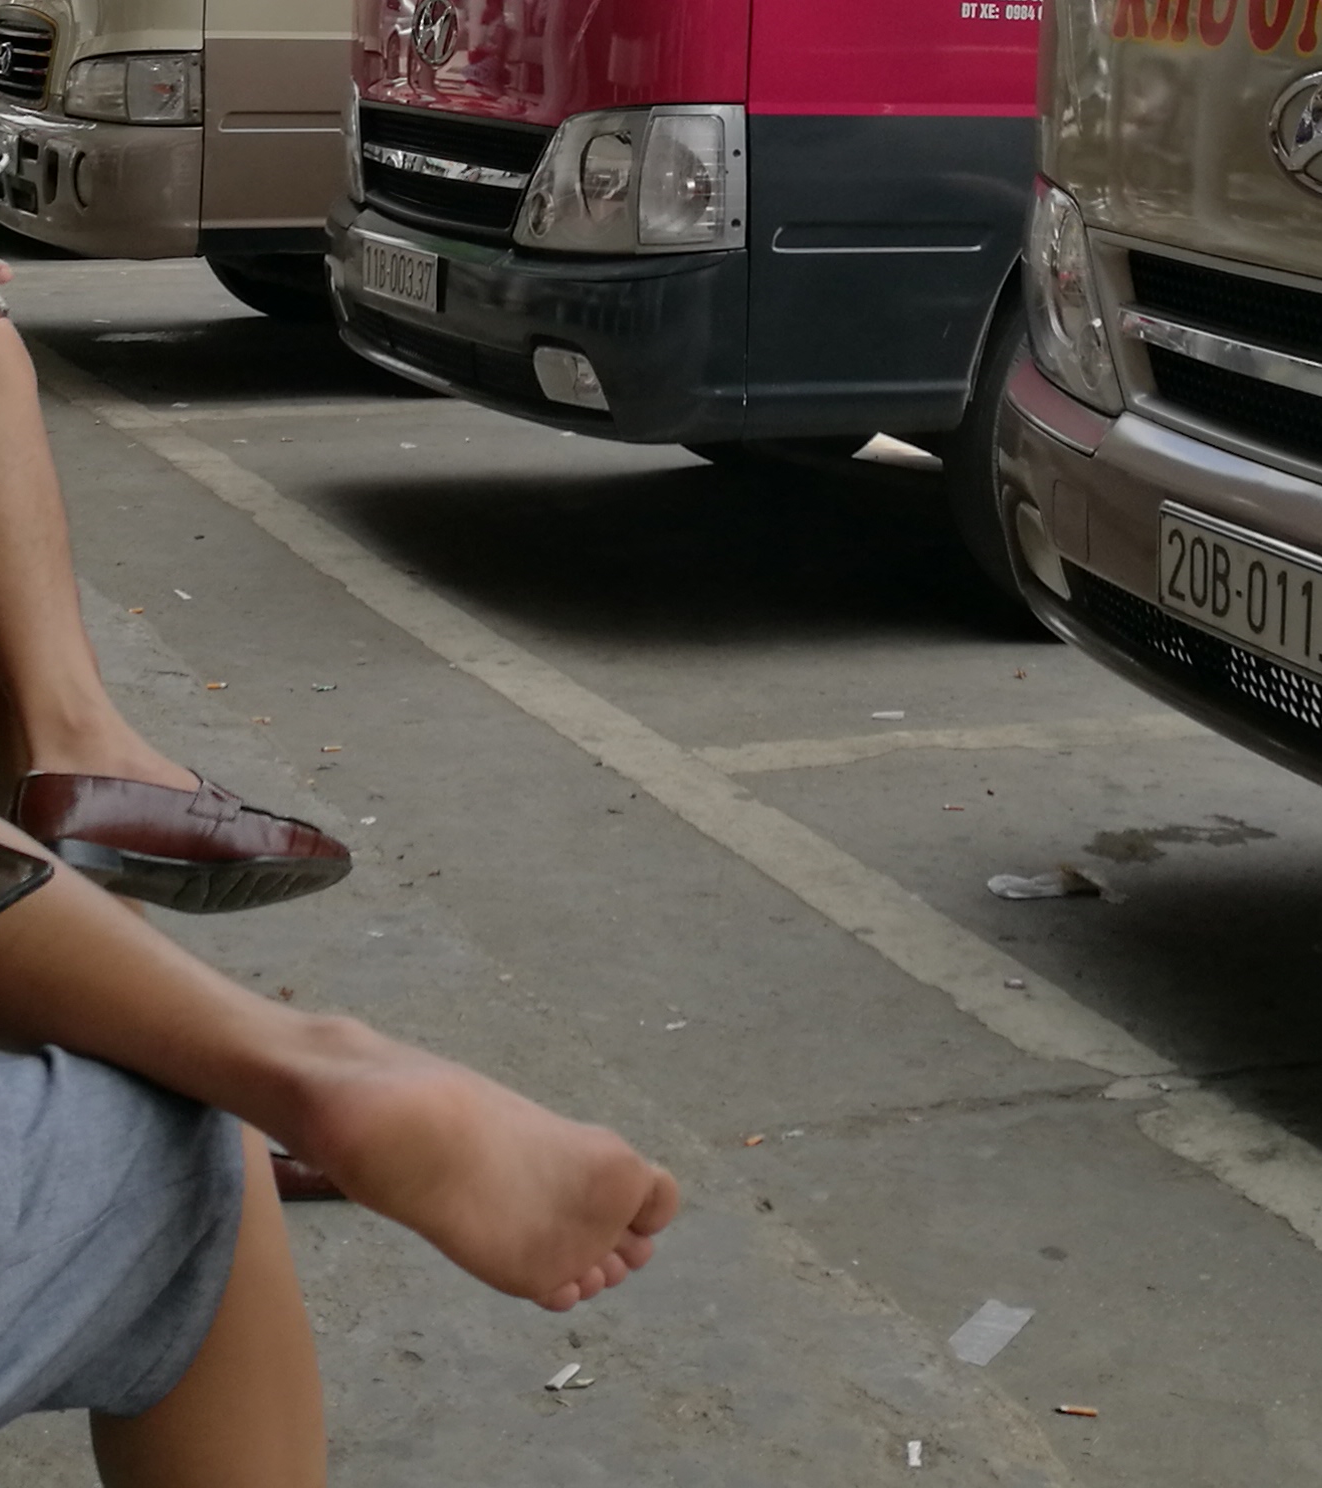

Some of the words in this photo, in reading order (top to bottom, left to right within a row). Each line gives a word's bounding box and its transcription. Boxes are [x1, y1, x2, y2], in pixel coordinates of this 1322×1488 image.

[961, 2, 977, 19] ĐT
[979, 3, 1000, 20] XE:
[366, 245, 433, 303] 11B-003.37
